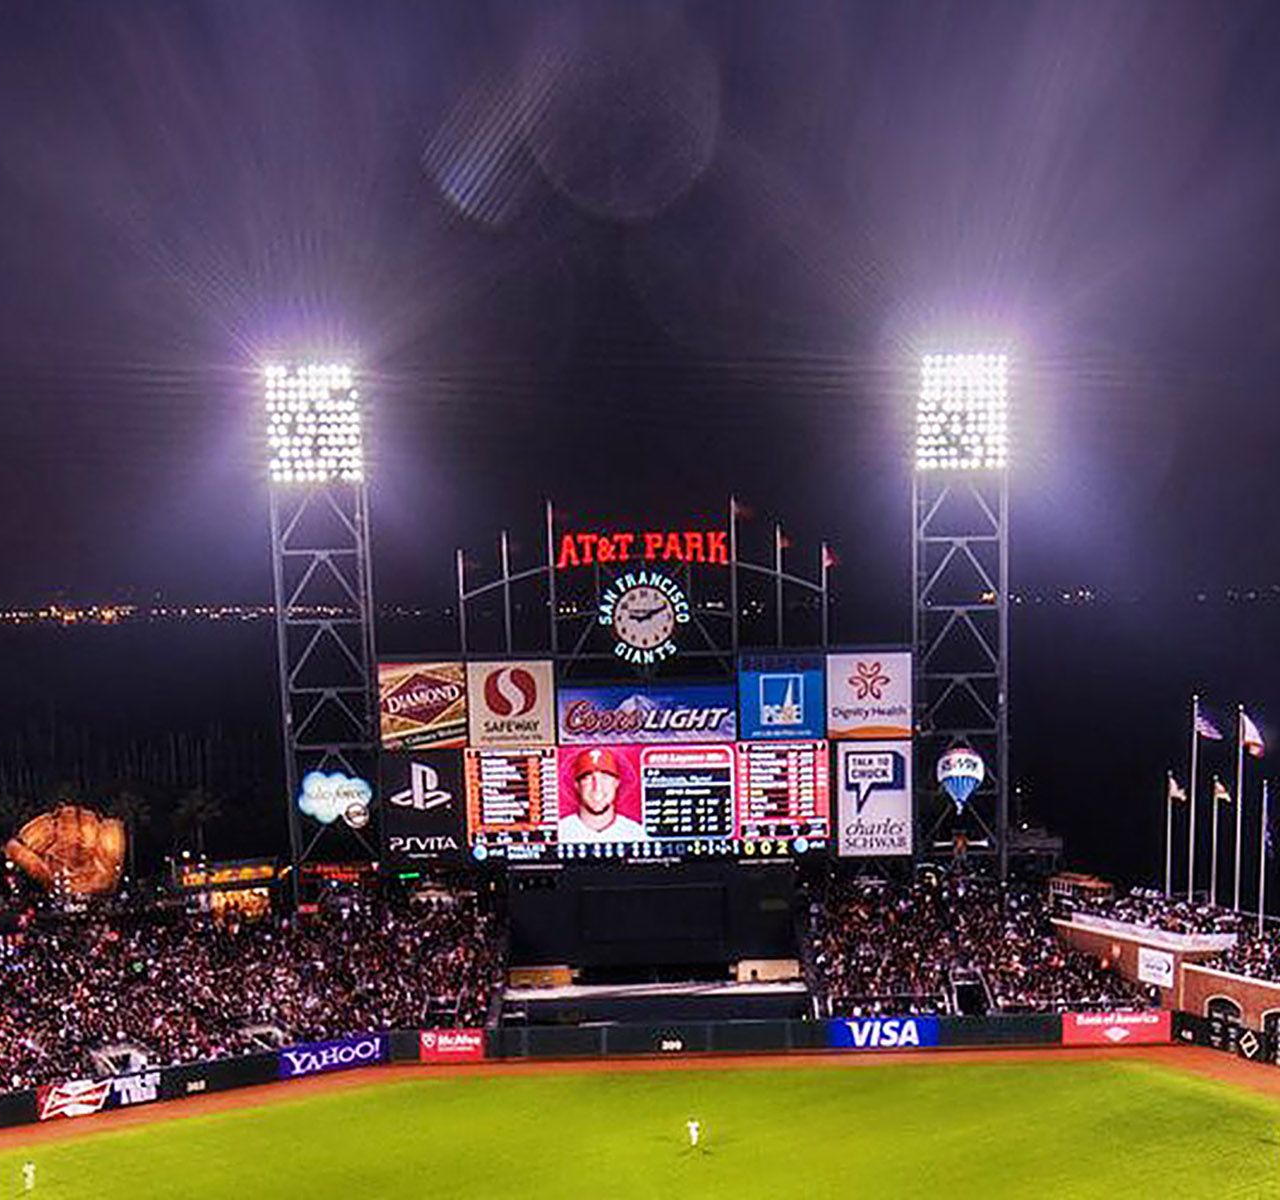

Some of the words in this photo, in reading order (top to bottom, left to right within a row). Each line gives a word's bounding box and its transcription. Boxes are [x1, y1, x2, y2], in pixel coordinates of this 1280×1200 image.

[557, 532, 634, 568] AT&T
[644, 531, 728, 565] PARK
[598, 589, 618, 626] SAN
[615, 571, 690, 624] FRANCISCO
[614, 640, 677, 664] GIANTS
[387, 684, 460, 714] DIAMOND
[483, 720, 540, 733] SAFEWAY
[644, 708, 728, 731] LIGHT
[845, 837, 907, 850] SCHWAB
[846, 1020, 919, 1047] VISA
[283, 1037, 381, 1075] YAHOO!
